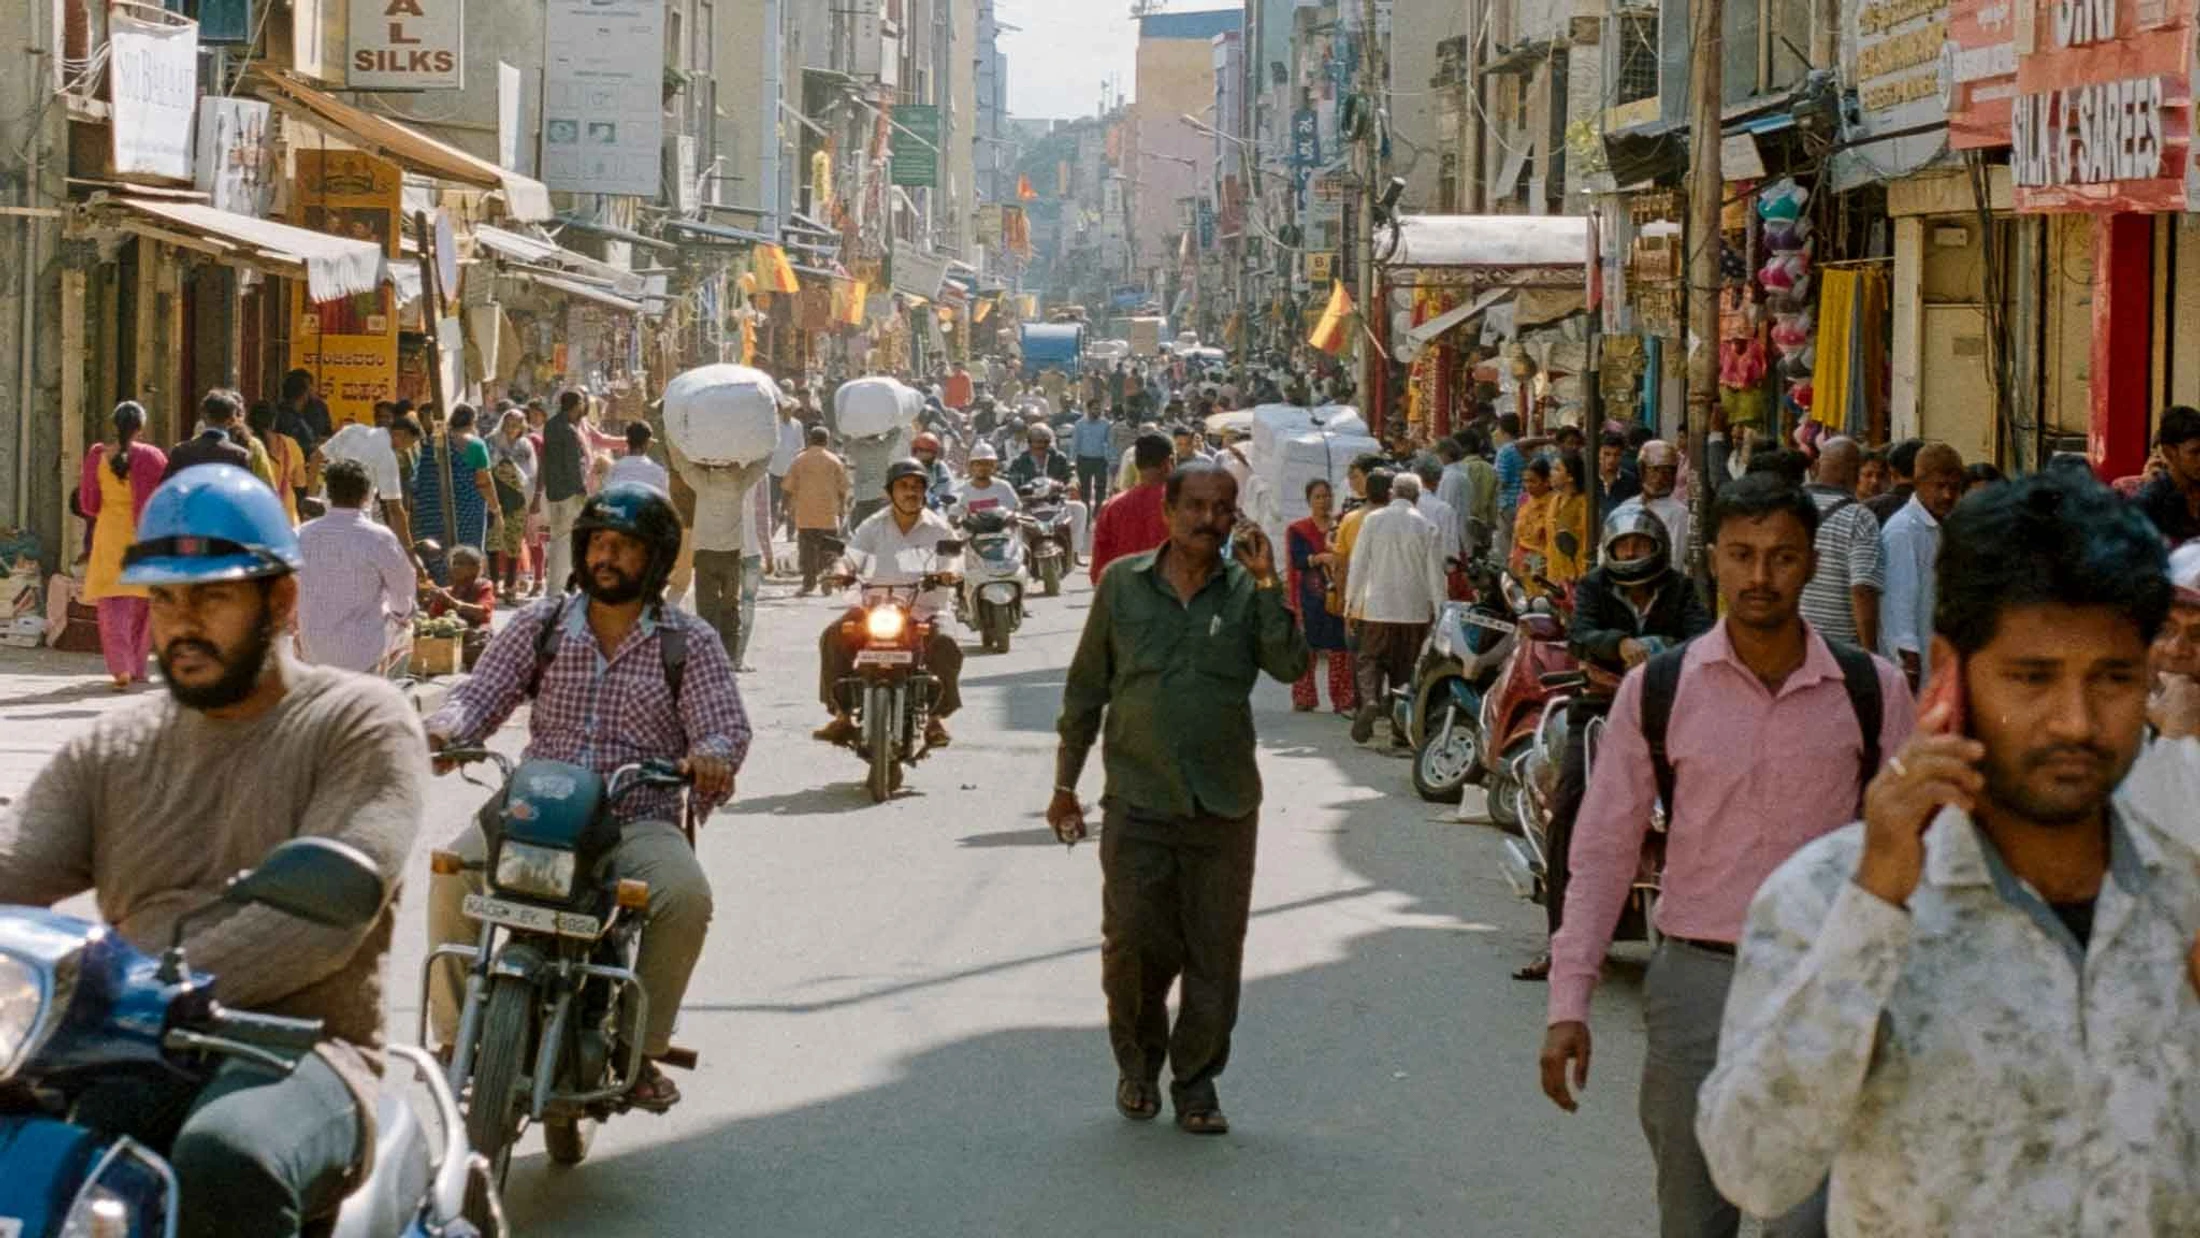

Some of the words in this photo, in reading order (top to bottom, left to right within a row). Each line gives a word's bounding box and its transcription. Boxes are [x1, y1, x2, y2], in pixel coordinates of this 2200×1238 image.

[354, 49, 454, 73] SILKS
[2010, 90, 2051, 187] SILK
[2077, 75, 2163, 184] SAREES
